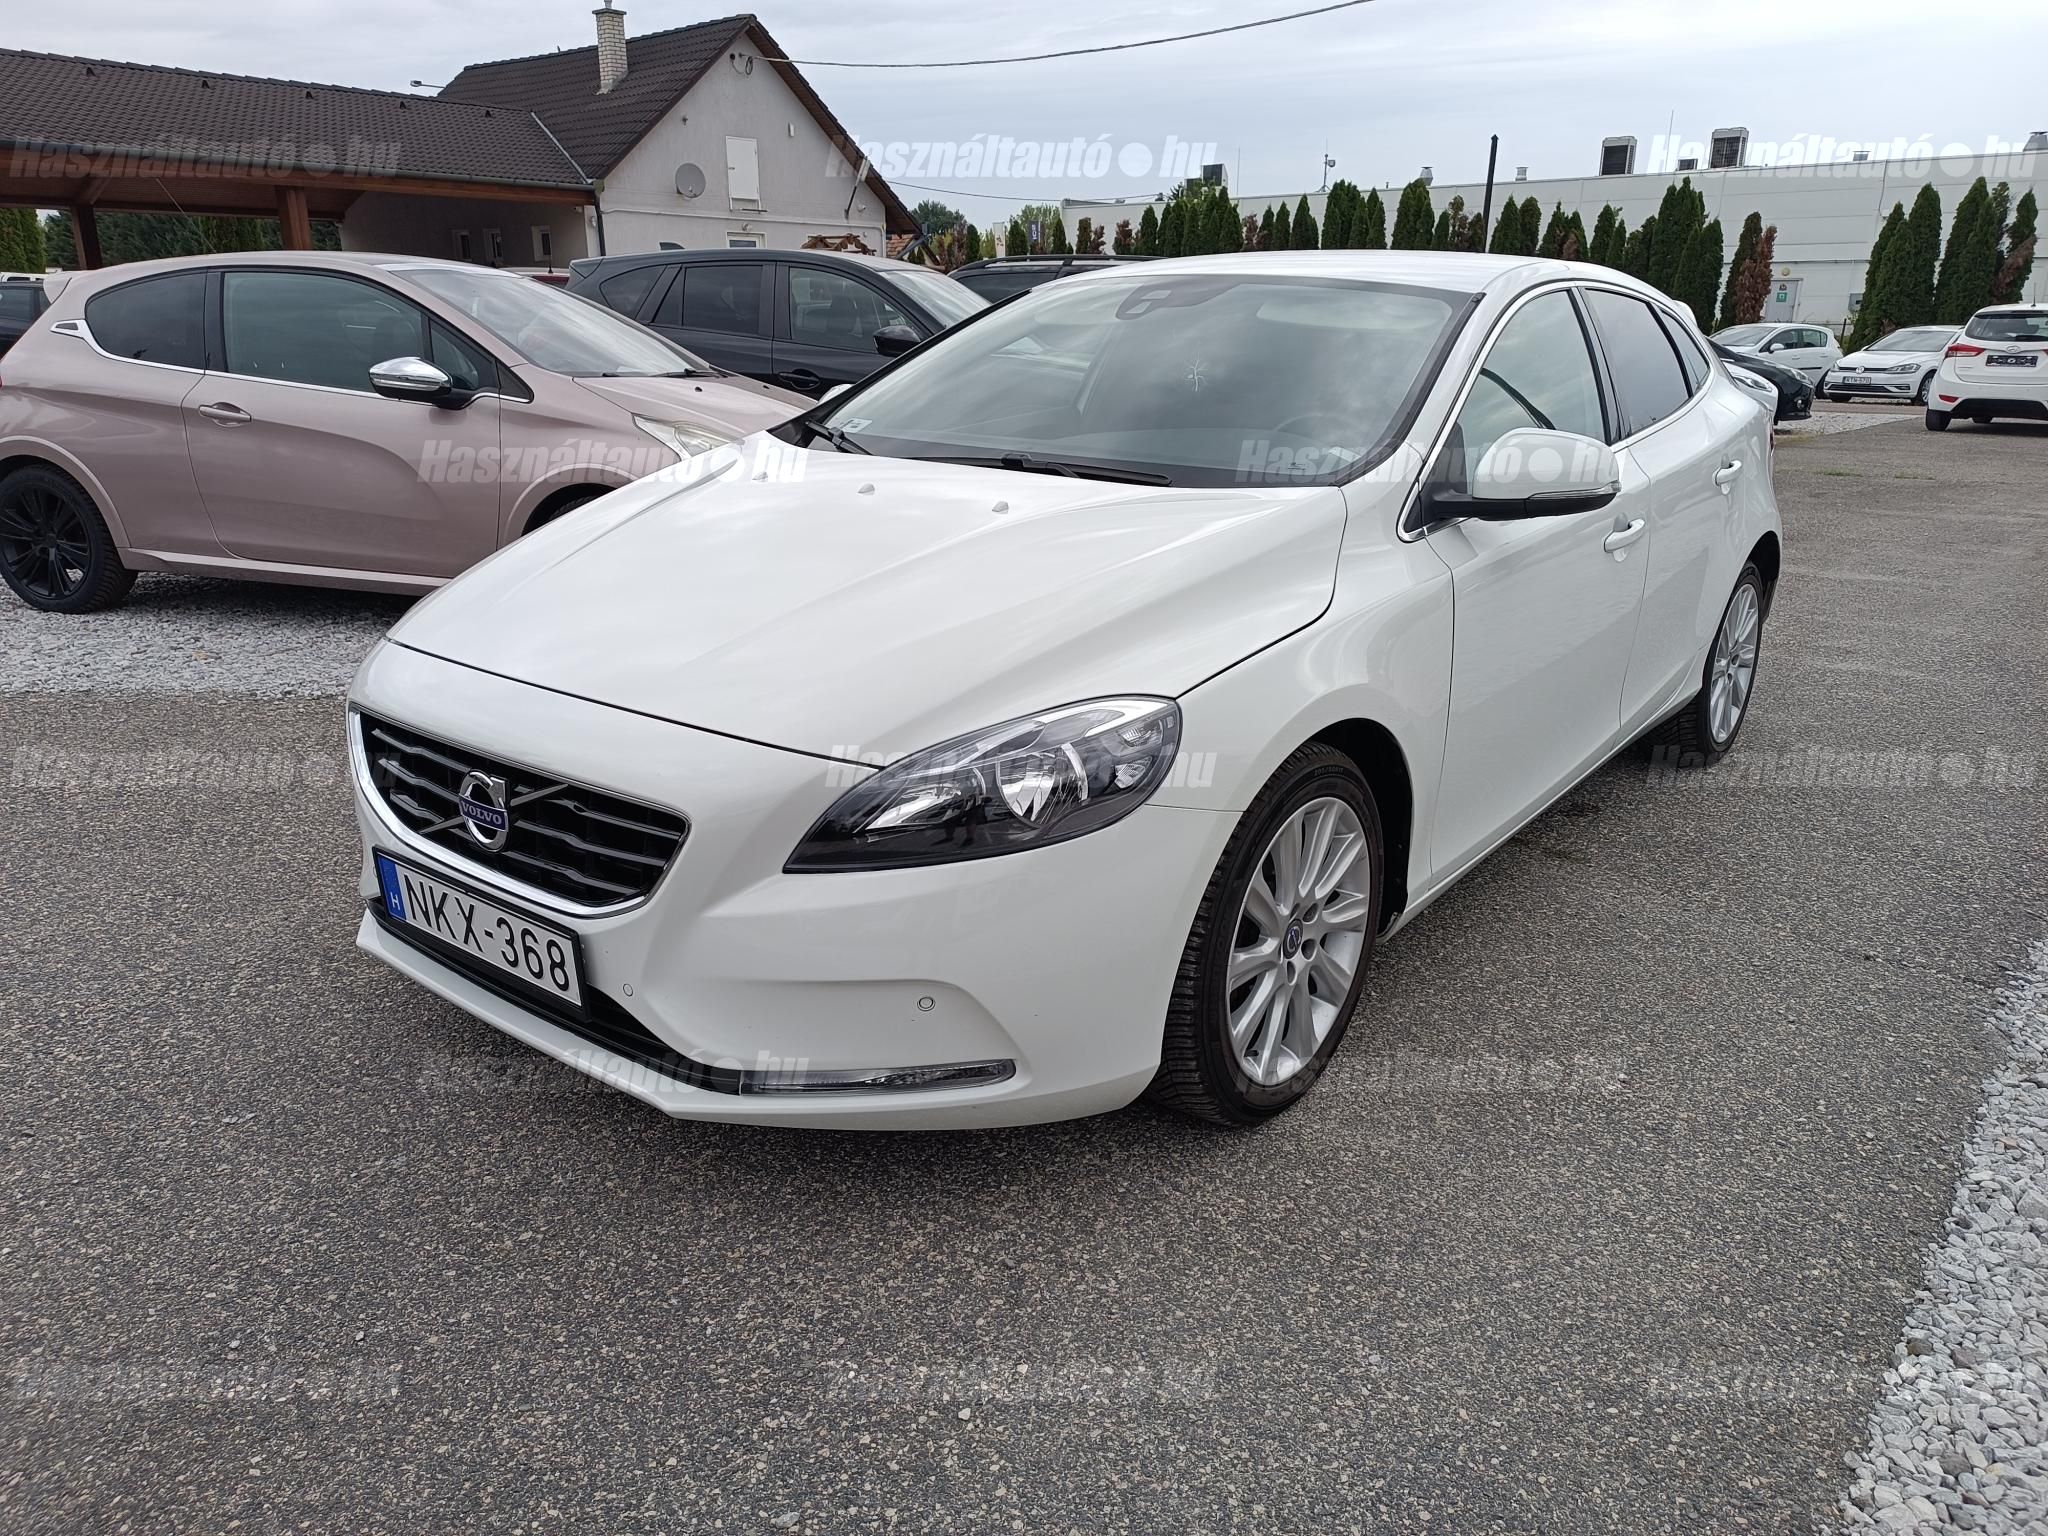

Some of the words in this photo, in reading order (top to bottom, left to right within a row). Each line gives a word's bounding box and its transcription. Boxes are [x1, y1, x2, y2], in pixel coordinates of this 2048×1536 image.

[461, 801, 502, 825] VOLVO
[390, 892, 400, 910] H
[404, 874, 570, 991] NKX-368
